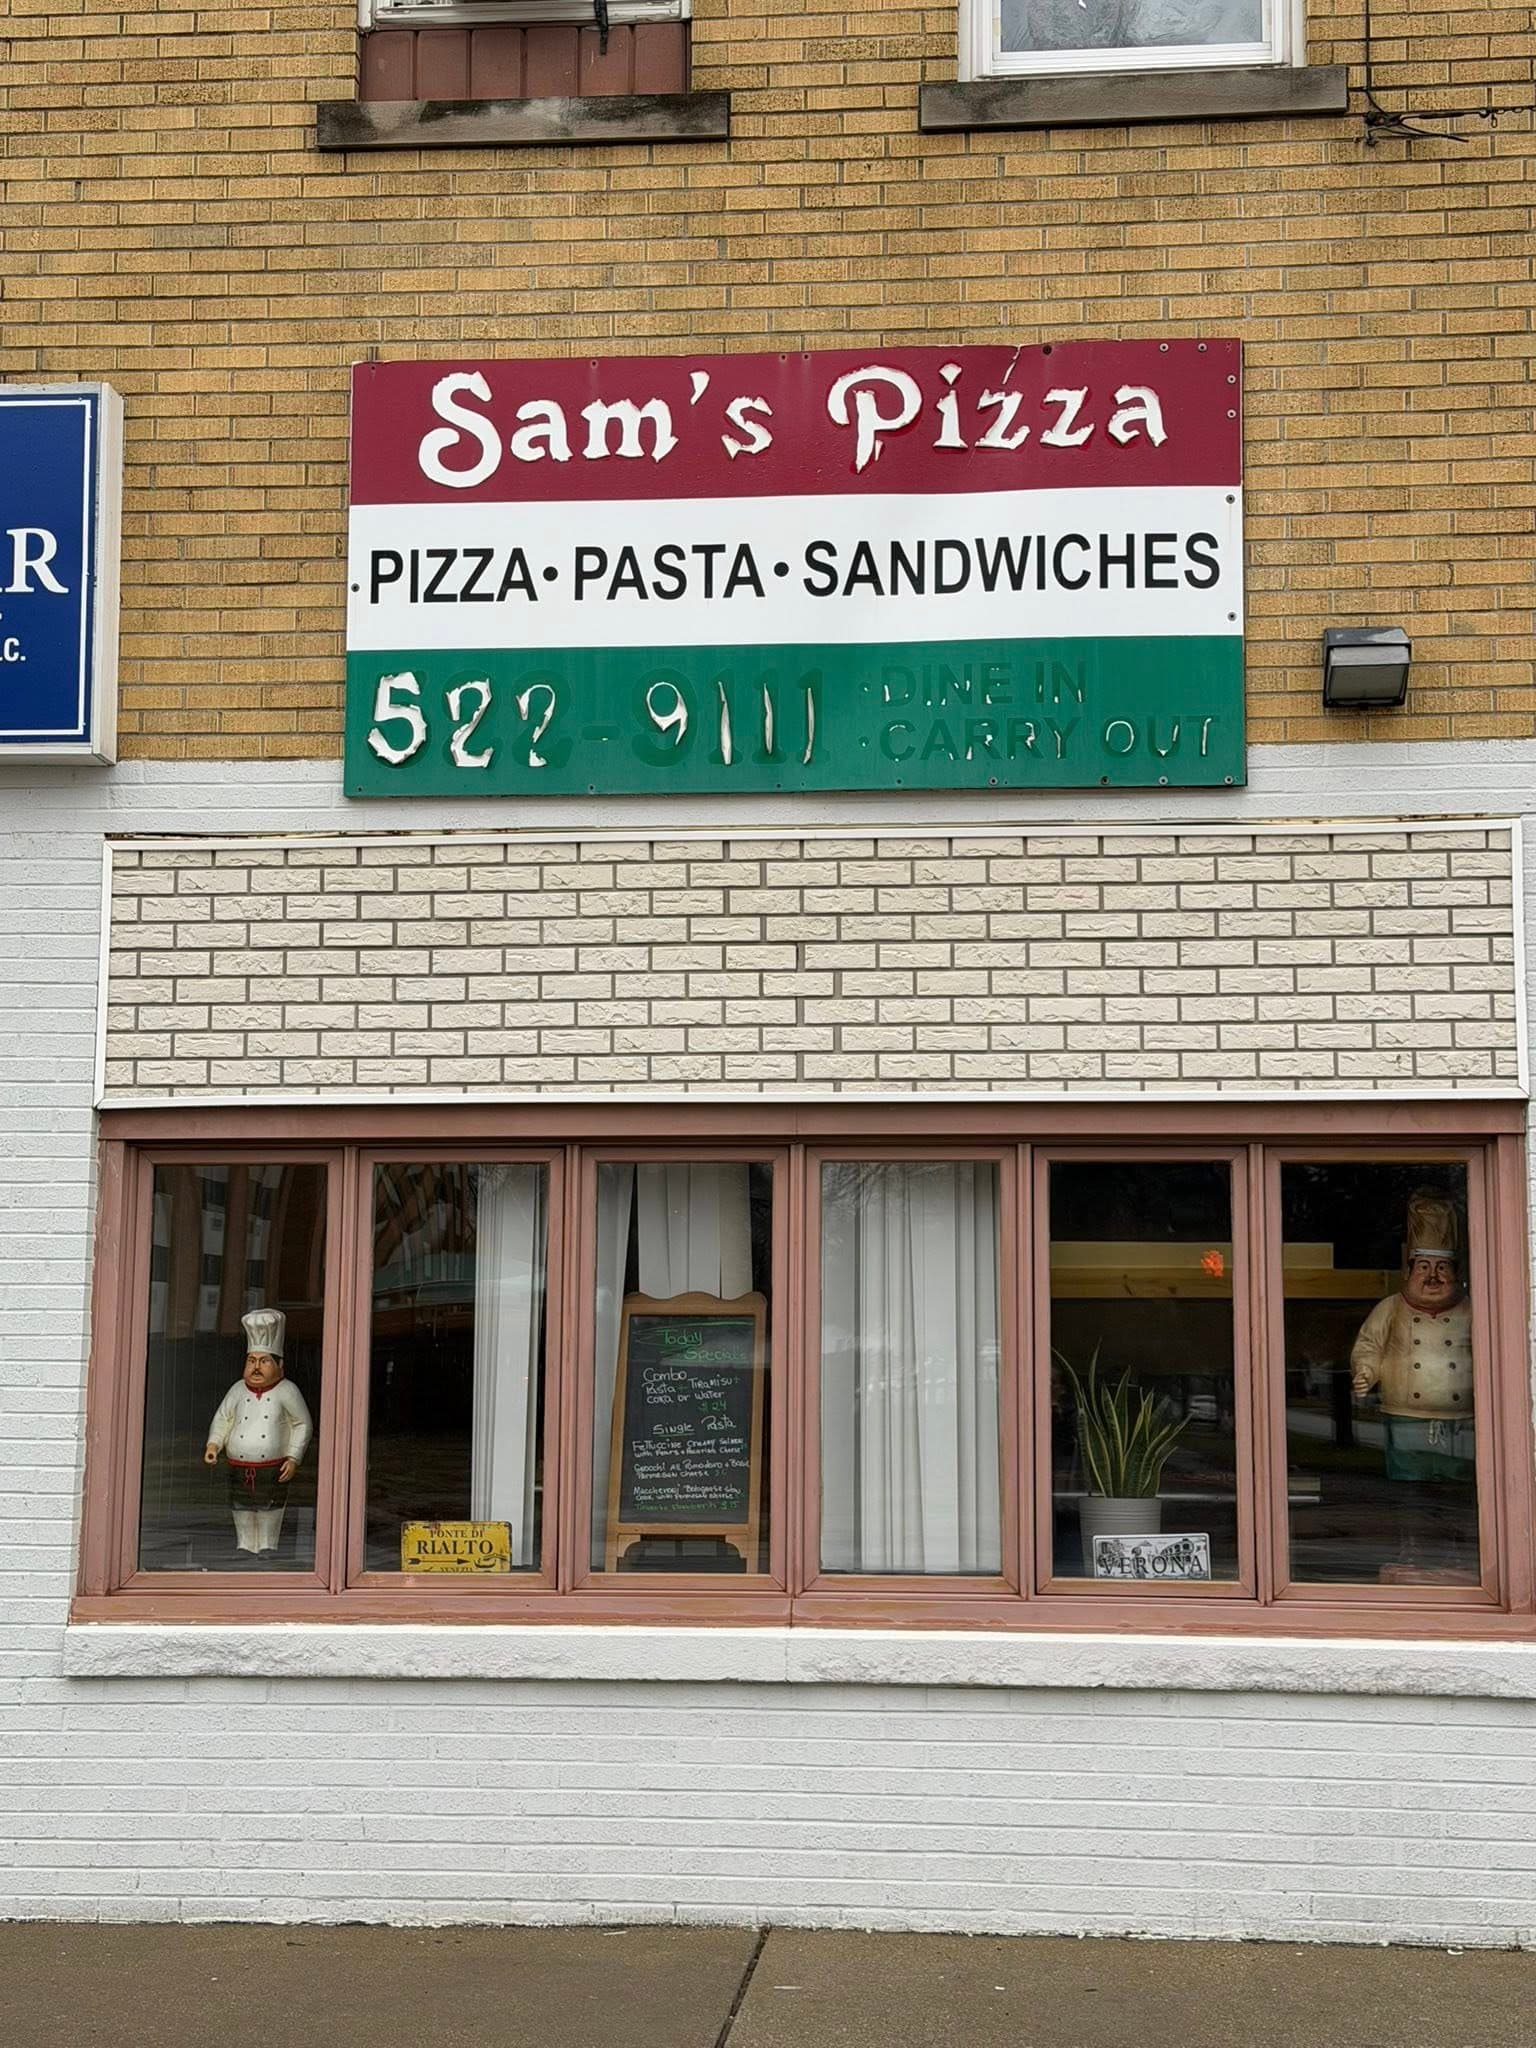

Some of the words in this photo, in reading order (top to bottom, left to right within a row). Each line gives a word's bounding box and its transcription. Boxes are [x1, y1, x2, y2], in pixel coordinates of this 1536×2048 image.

[418, 370, 774, 488] Sam's
[828, 363, 1169, 473] Pizza
[0, 527, 69, 594] R
[369, 547, 539, 604] PIZZA
[573, 542, 767, 601] PASTA
[803, 531, 1221, 598] SANDWICHES
[880, 661, 1013, 706] DINE
[1034, 660, 1087, 704] IN
[878, 716, 1083, 762] CARRY
[1102, 715, 1221, 761] OUT
[643, 1367, 687, 1382] Combo
[416, 1540, 494, 1555] RIALTO
[430, 1529, 467, 1538] PONTE
[471, 1529, 483, 1538] DI
[1102, 1555, 1204, 1574] VERONA
